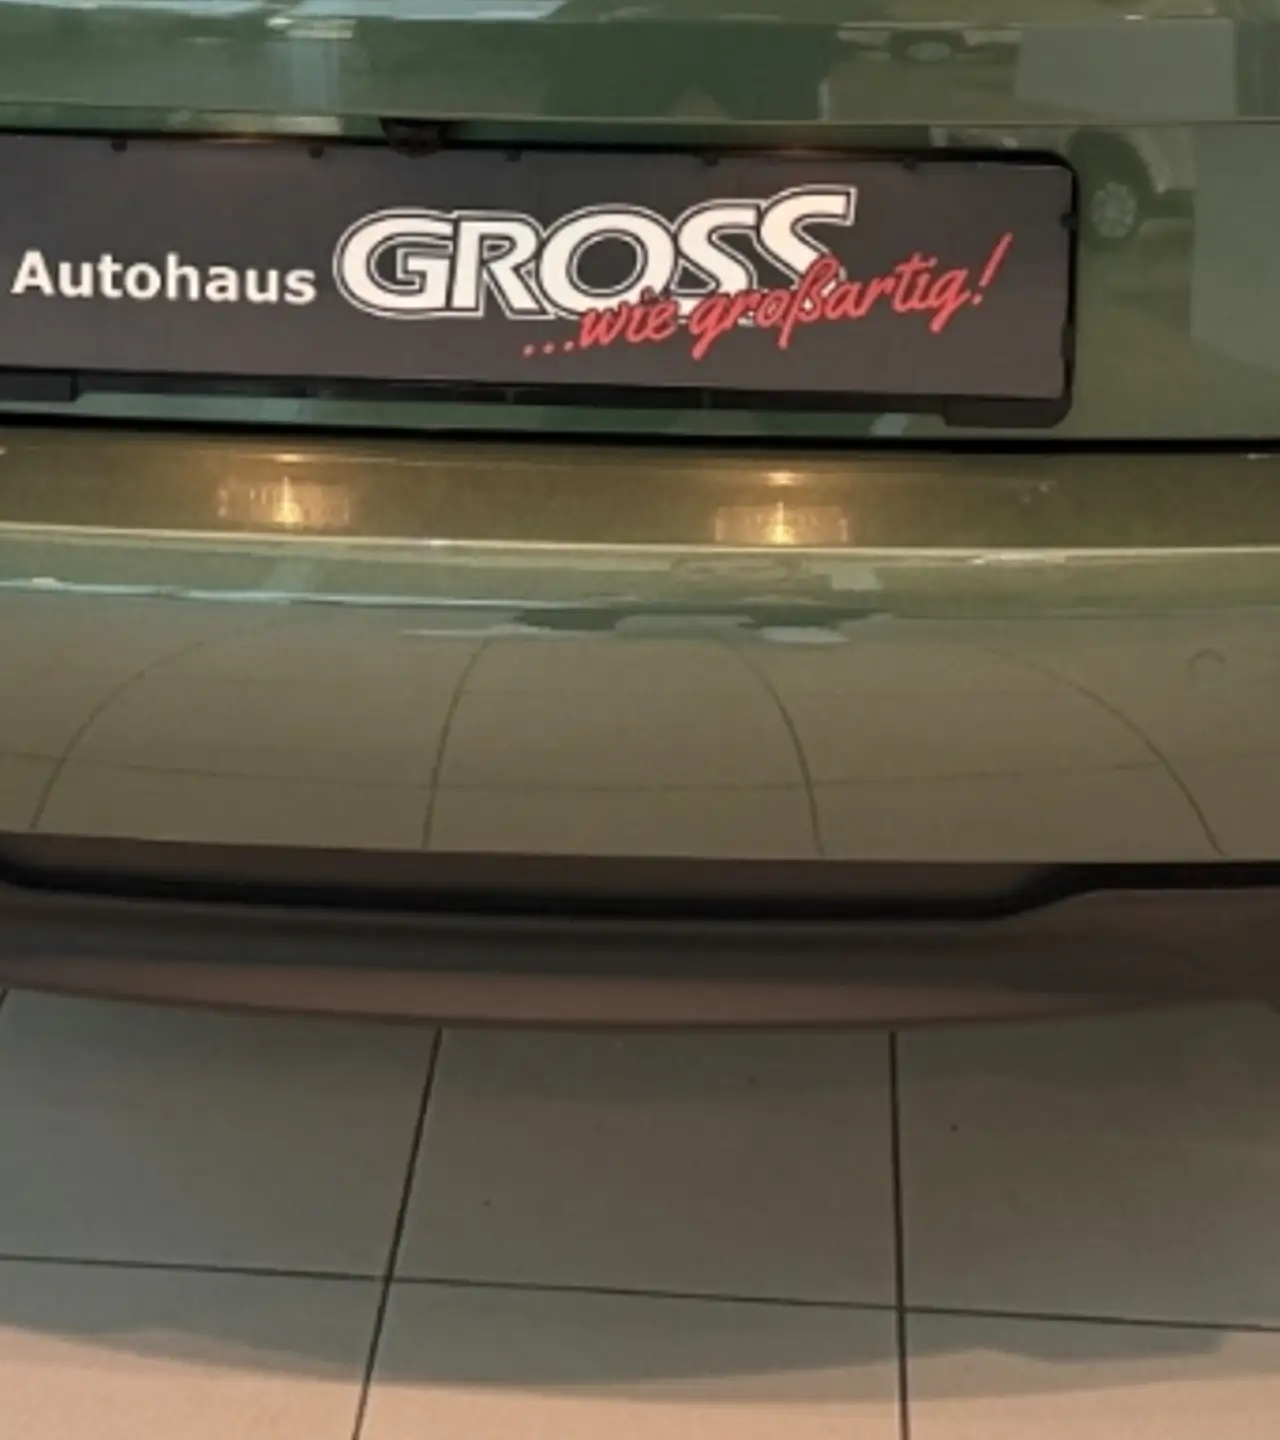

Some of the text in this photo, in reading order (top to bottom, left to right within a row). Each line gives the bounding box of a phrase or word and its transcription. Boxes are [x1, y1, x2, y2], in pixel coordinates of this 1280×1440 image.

[10, 183, 857, 326] Autohaus GROSS
[688, 231, 1013, 360] großartig!
